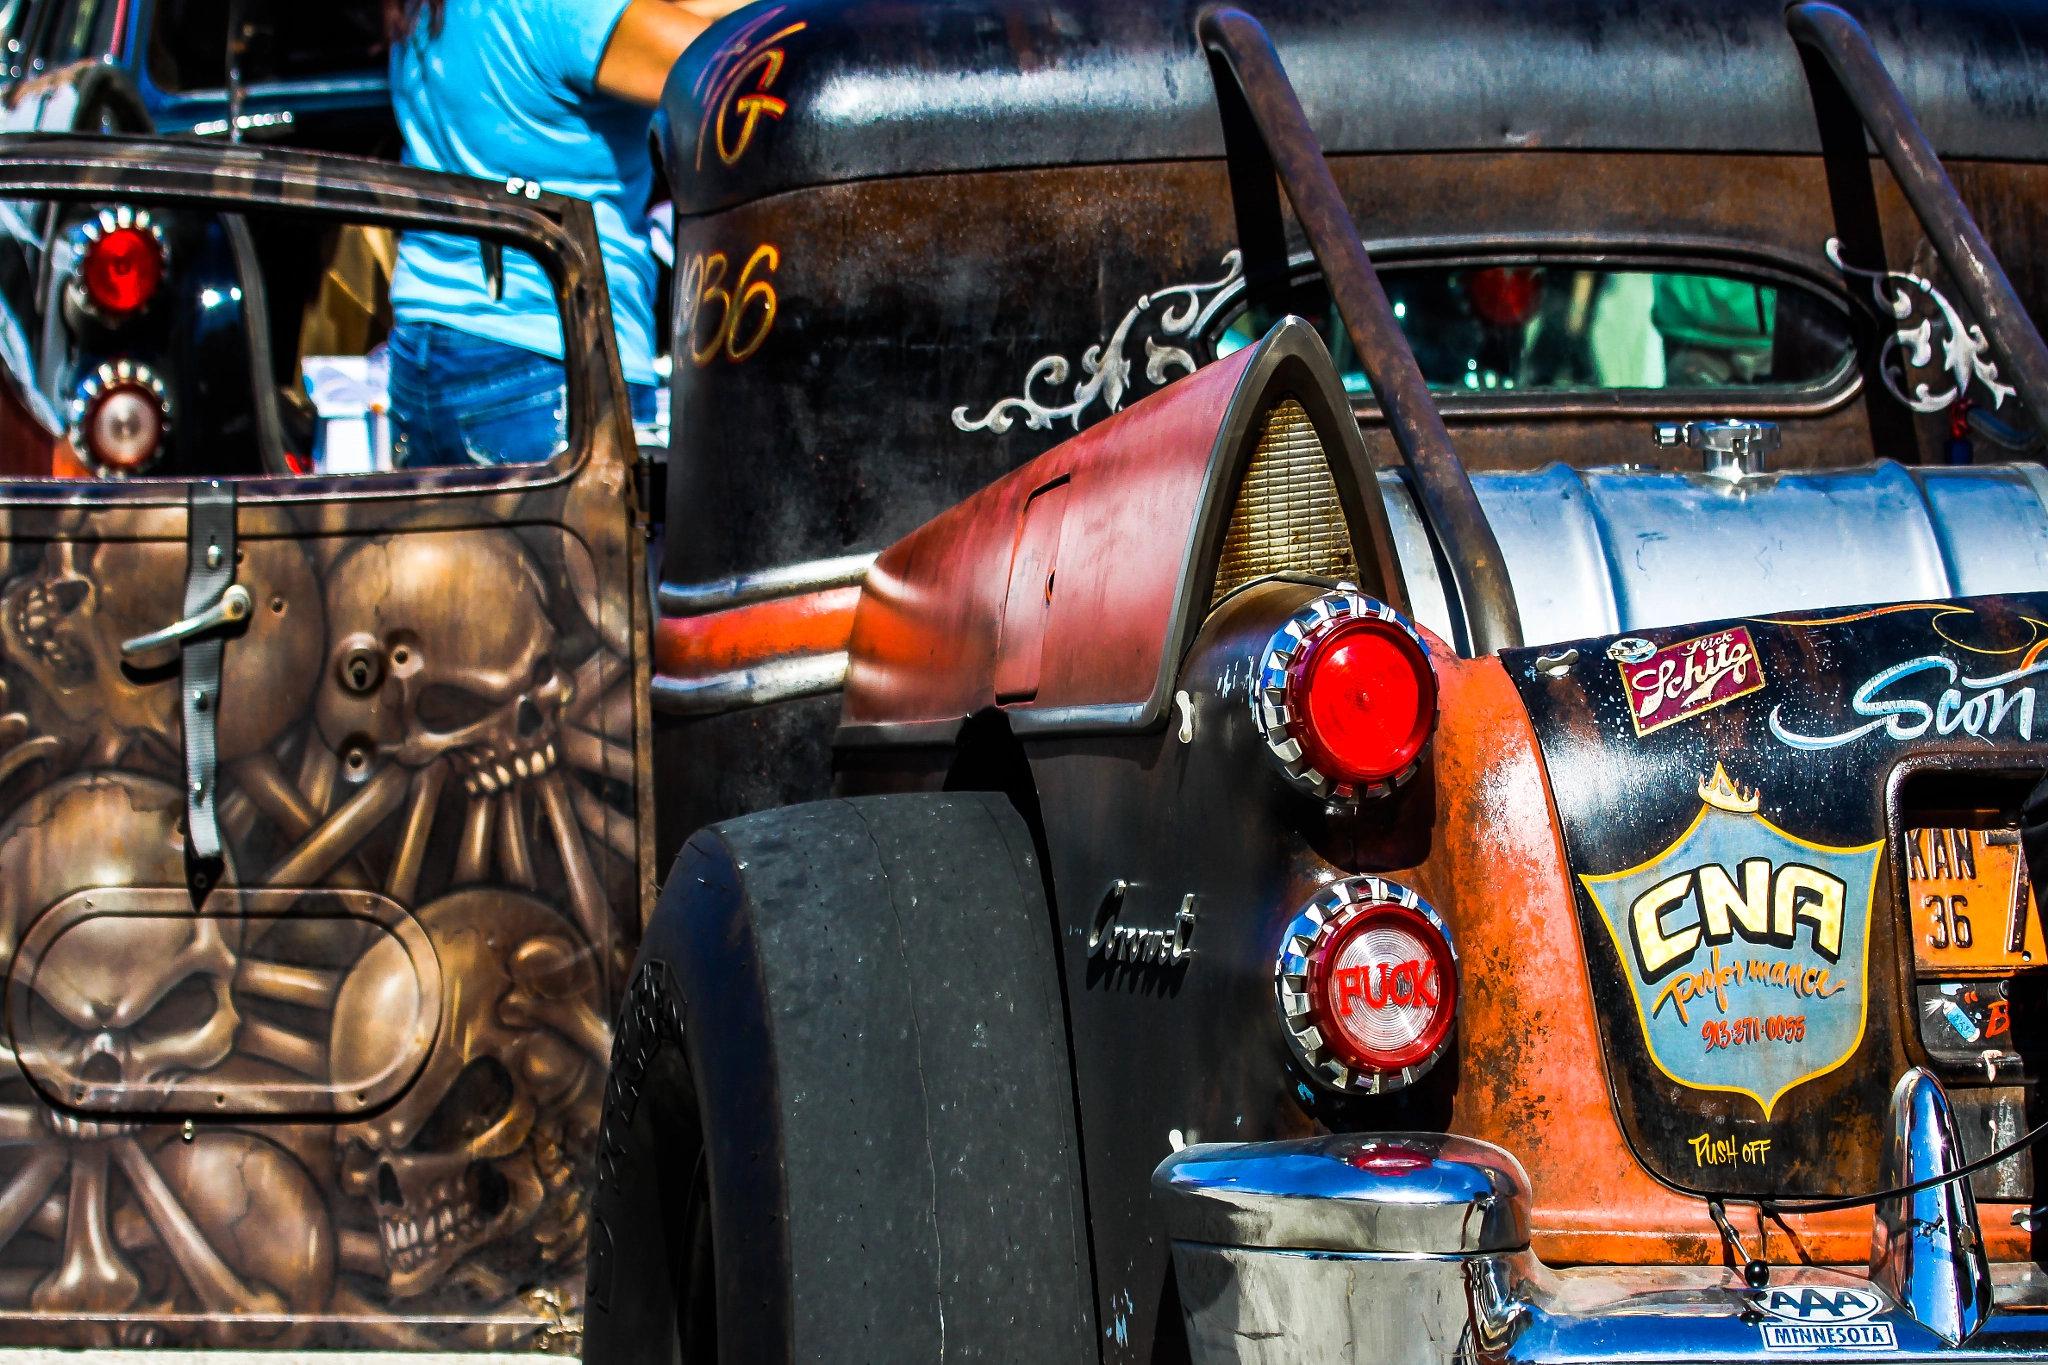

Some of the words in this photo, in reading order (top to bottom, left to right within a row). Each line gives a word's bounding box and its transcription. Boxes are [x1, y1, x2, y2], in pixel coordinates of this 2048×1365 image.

[1904, 827, 1977, 880] KAN
[1628, 857, 1848, 985] CNA
[1924, 894, 1974, 949] 36
[1335, 959, 1439, 1016] FUCK
[1687, 1132, 1739, 1171] PUSH
[1742, 1139, 1772, 1165] OFF
[1769, 1288, 1869, 1318] AAA
[1774, 1327, 1886, 1345] MINNESOTA
